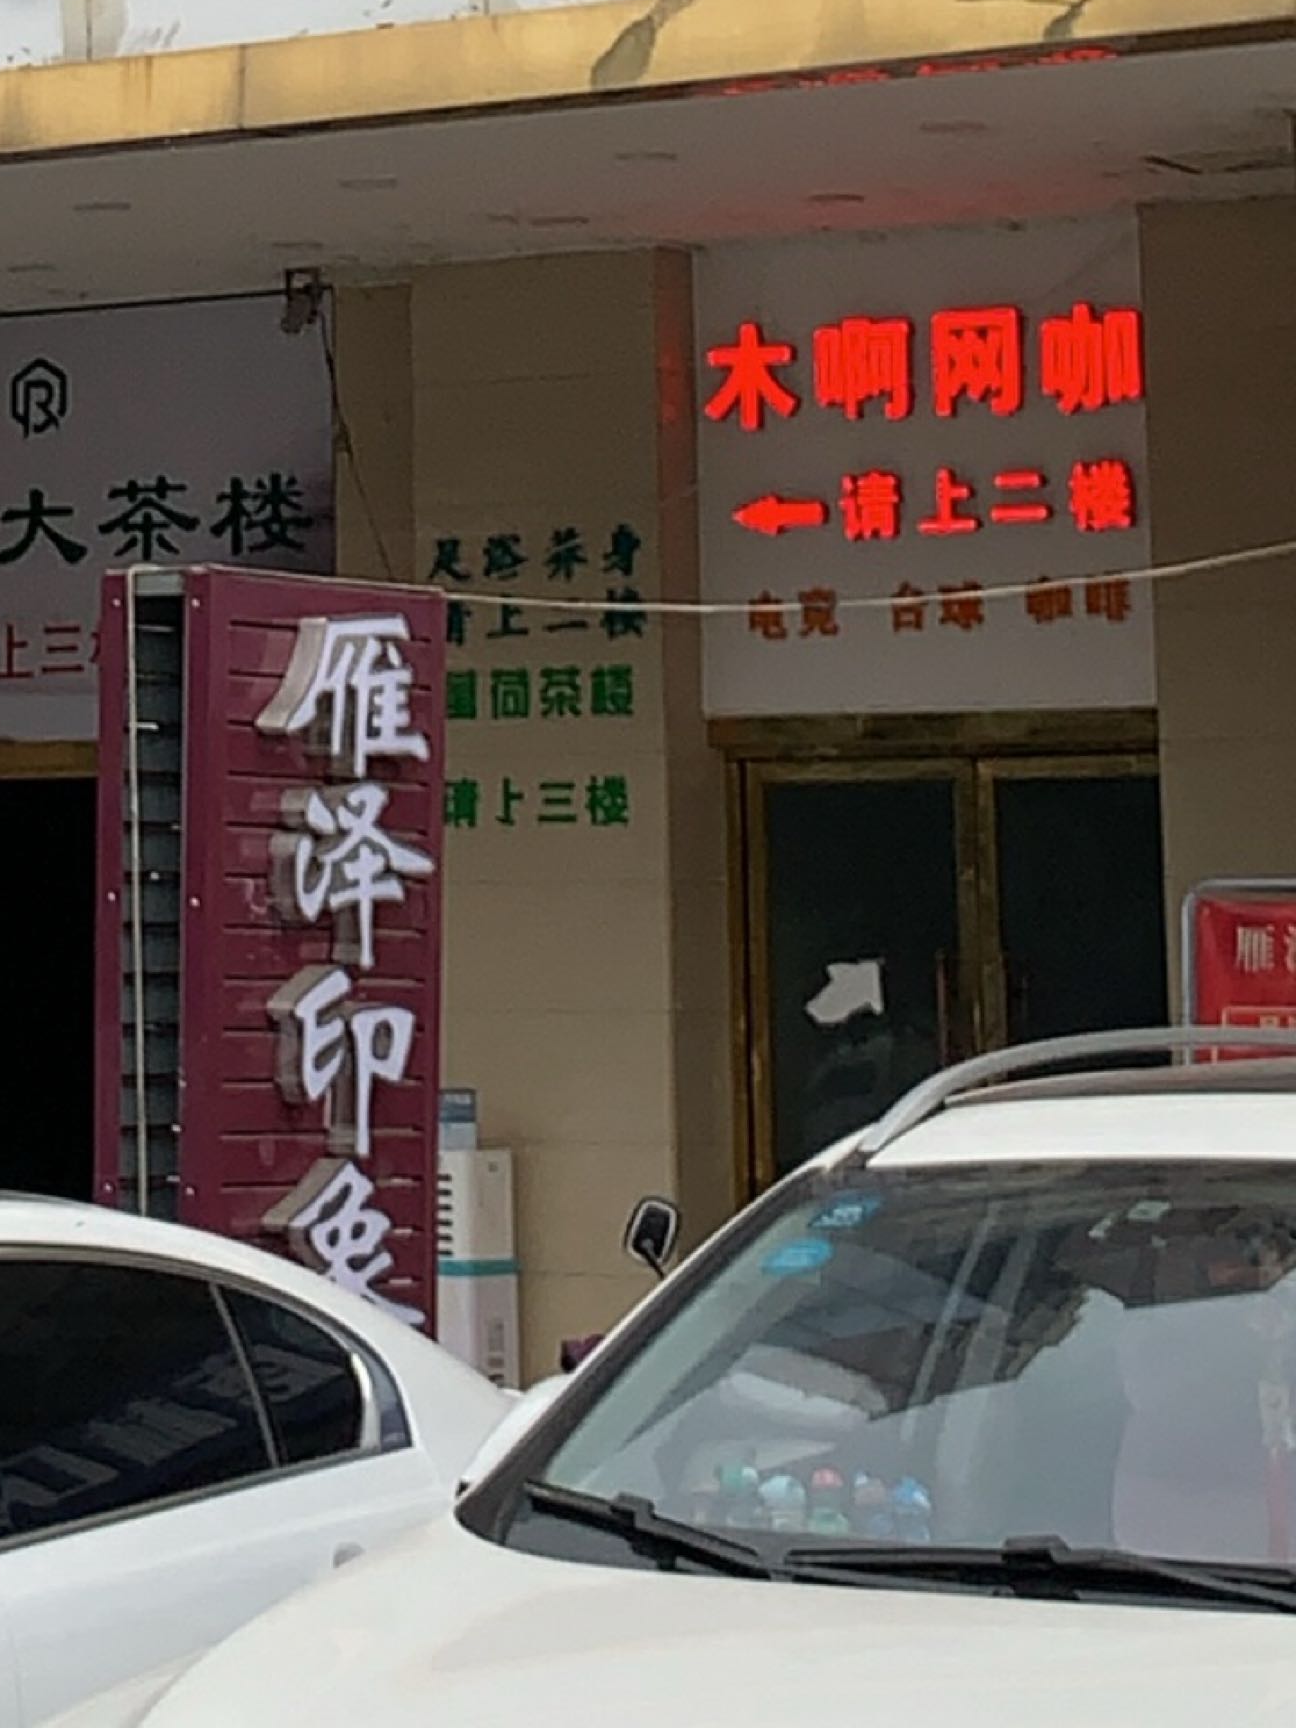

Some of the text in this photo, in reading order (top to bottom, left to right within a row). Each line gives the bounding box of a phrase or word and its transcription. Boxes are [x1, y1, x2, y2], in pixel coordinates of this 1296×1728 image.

[704, 302, 1142, 430] 木啊网咖
[840, 459, 1135, 541] 请上二楼
[282, 613, 435, 1327] 雁泽印象
